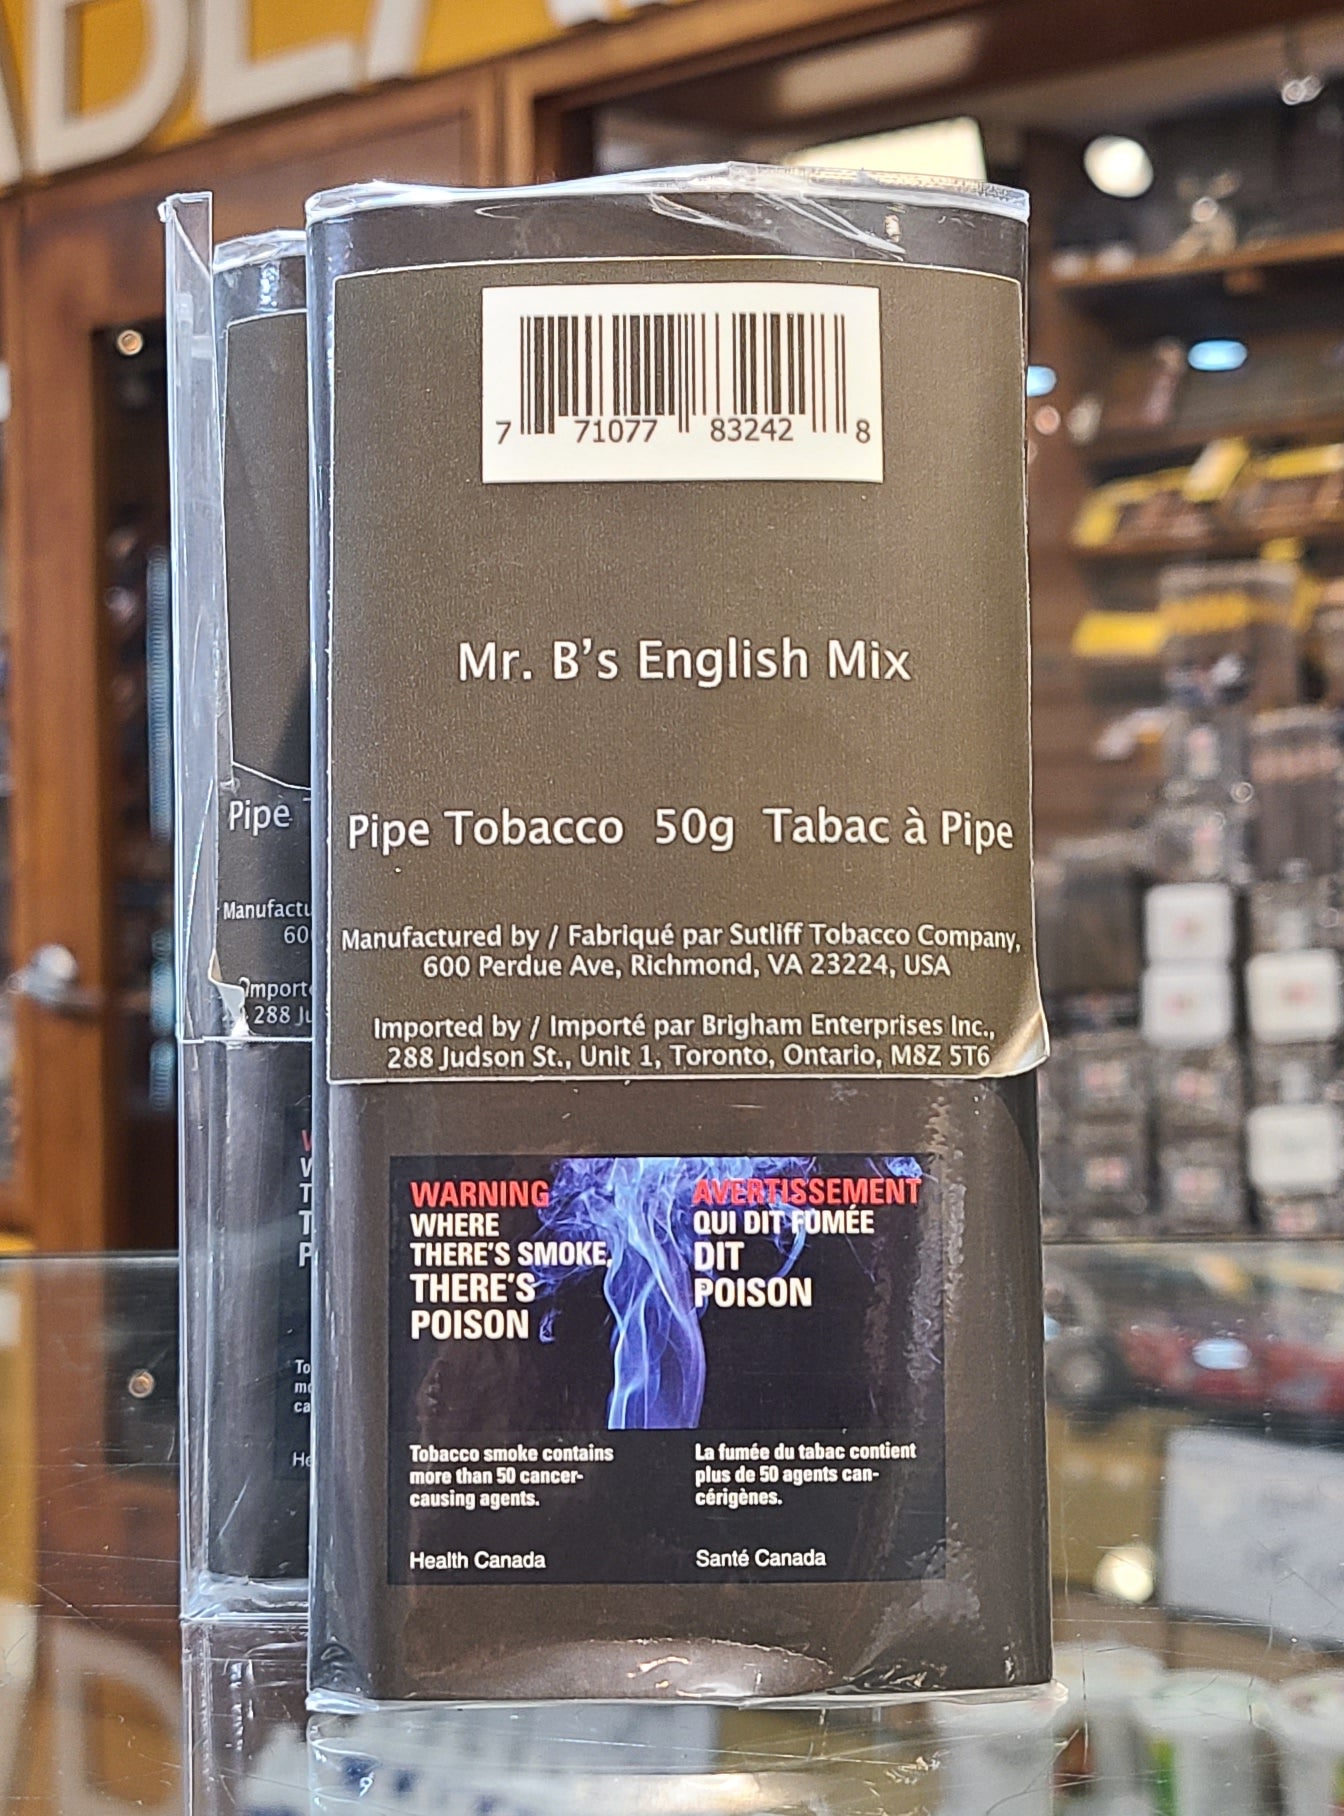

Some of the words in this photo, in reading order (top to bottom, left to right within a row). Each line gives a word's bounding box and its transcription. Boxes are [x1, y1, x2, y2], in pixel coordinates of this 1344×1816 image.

[495, 420, 512, 445] 7
[574, 418, 658, 444] 71077
[710, 417, 794, 443] 83242
[855, 419, 871, 444] 8
[459, 642, 532, 681] Mr.
[553, 638, 618, 680] B's
[639, 636, 808, 688] English
[828, 639, 911, 680] Mix
[228, 799, 292, 837] Pipe
[349, 813, 430, 856] Pipe
[443, 807, 624, 846] Tobacco
[656, 807, 734, 852] 50g
[762, 806, 890, 844] Tabac
[904, 806, 928, 845] à
[942, 810, 1013, 855] Pipe
[283, 925, 312, 945] 60
[342, 924, 502, 951] Manufactured
[511, 924, 540, 951] by
[548, 924, 559, 951] /
[569, 922, 674, 951] Fabriqué
[683, 928, 723, 950] par
[729, 921, 804, 945] Sutliff
[808, 921, 910, 945] Tobacco
[917, 924, 1021, 953] Company,
[423, 955, 471, 978] 600
[479, 953, 562, 978] Perdue
[569, 955, 622, 979] Ave,
[631, 952, 760, 978] Richmond,
[767, 953, 803, 975] VA
[810, 952, 896, 979] 23224,
[904, 953, 951, 976] USA
[374, 1015, 482, 1043] Imported
[492, 1014, 522, 1042] by
[529, 1015, 541, 1041] /
[550, 1013, 646, 1041] Importé
[654, 1018, 695, 1041] par
[702, 1012, 802, 1041] Brigham
[811, 1013, 943, 1040] Enterprises
[951, 1014, 995, 1041] Inc.,
[387, 1046, 434, 1069] 288
[438, 1044, 525, 1072] Judson
[532, 1045, 572, 1070] St.,
[580, 1044, 631, 1067] Unit
[640, 1044, 662, 1070] 1,
[669, 1044, 775, 1070] Toronto,
[783, 1043, 882, 1069] Ontario,
[891, 1043, 942, 1066] M8Z
[949, 1043, 991, 1067] 5T6
[411, 1180, 548, 1207] WARNING
[694, 1177, 922, 1206] AVERTISSEMENT
[409, 1212, 500, 1238] WHERE
[693, 1210, 737, 1236] QUI
[743, 1209, 787, 1235] DIT
[790, 1203, 875, 1235] FUMÉE
[409, 1241, 511, 1267] THERE'S
[517, 1240, 615, 1270] SMOKE,
[693, 1241, 745, 1272] DIT
[409, 1272, 537, 1304] THERE'S
[694, 1276, 812, 1308] POISON
[411, 1309, 529, 1340] POISON
[409, 1444, 480, 1463] Tobacco
[483, 1443, 539, 1462] smoke
[542, 1443, 614, 1462] contains
[695, 1442, 715, 1461] La
[717, 1442, 771, 1461] fumée
[773, 1442, 795, 1460] du
[797, 1441, 846, 1460] tabac
[849, 1441, 917, 1460] contient
[409, 1471, 452, 1485] more
[455, 1466, 493, 1485] than
[496, 1466, 517, 1485] 50
[519, 1470, 584, 1484] cancer-
[695, 1465, 732, 1487] plus
[734, 1464, 756, 1483] de
[759, 1464, 780, 1483] 50
[782, 1466, 839, 1486] agents
[841, 1468, 880, 1482] can-
[409, 1489, 476, 1511] causing
[479, 1490, 540, 1511] agents.
[695, 1487, 783, 1510] cérigènes.
[409, 1551, 469, 1570] Health
[474, 1550, 547, 1570] Canada
[695, 1548, 750, 1568] Santé
[754, 1548, 827, 1567] Canada
